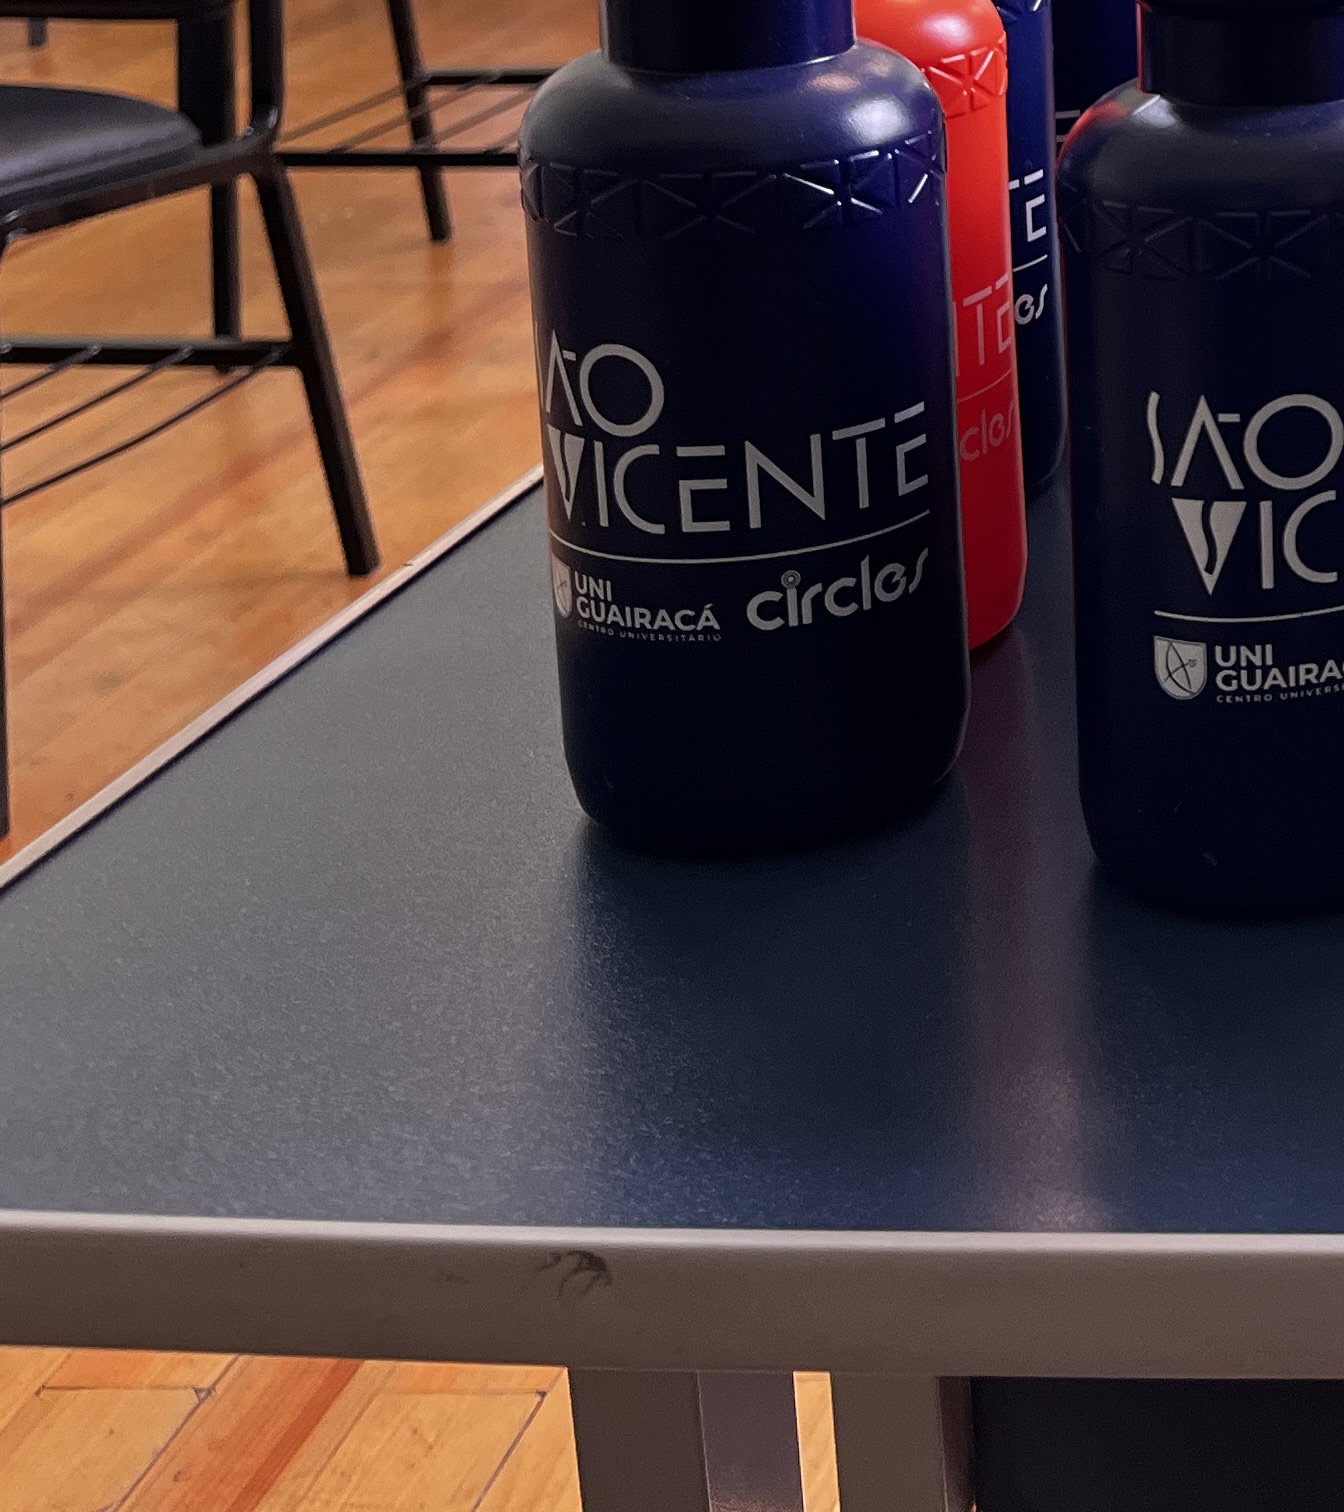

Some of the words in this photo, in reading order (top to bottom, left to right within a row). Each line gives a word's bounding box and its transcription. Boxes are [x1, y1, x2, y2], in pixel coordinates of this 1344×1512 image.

[545, 329, 665, 437] ÃO
[547, 400, 930, 535] VICENTE
[574, 569, 612, 598] UNI
[746, 547, 930, 631] circles
[575, 595, 721, 632] GUAIRACÁ
[1214, 644, 1273, 667] UNI
[1216, 691, 1273, 704] CENTRO
